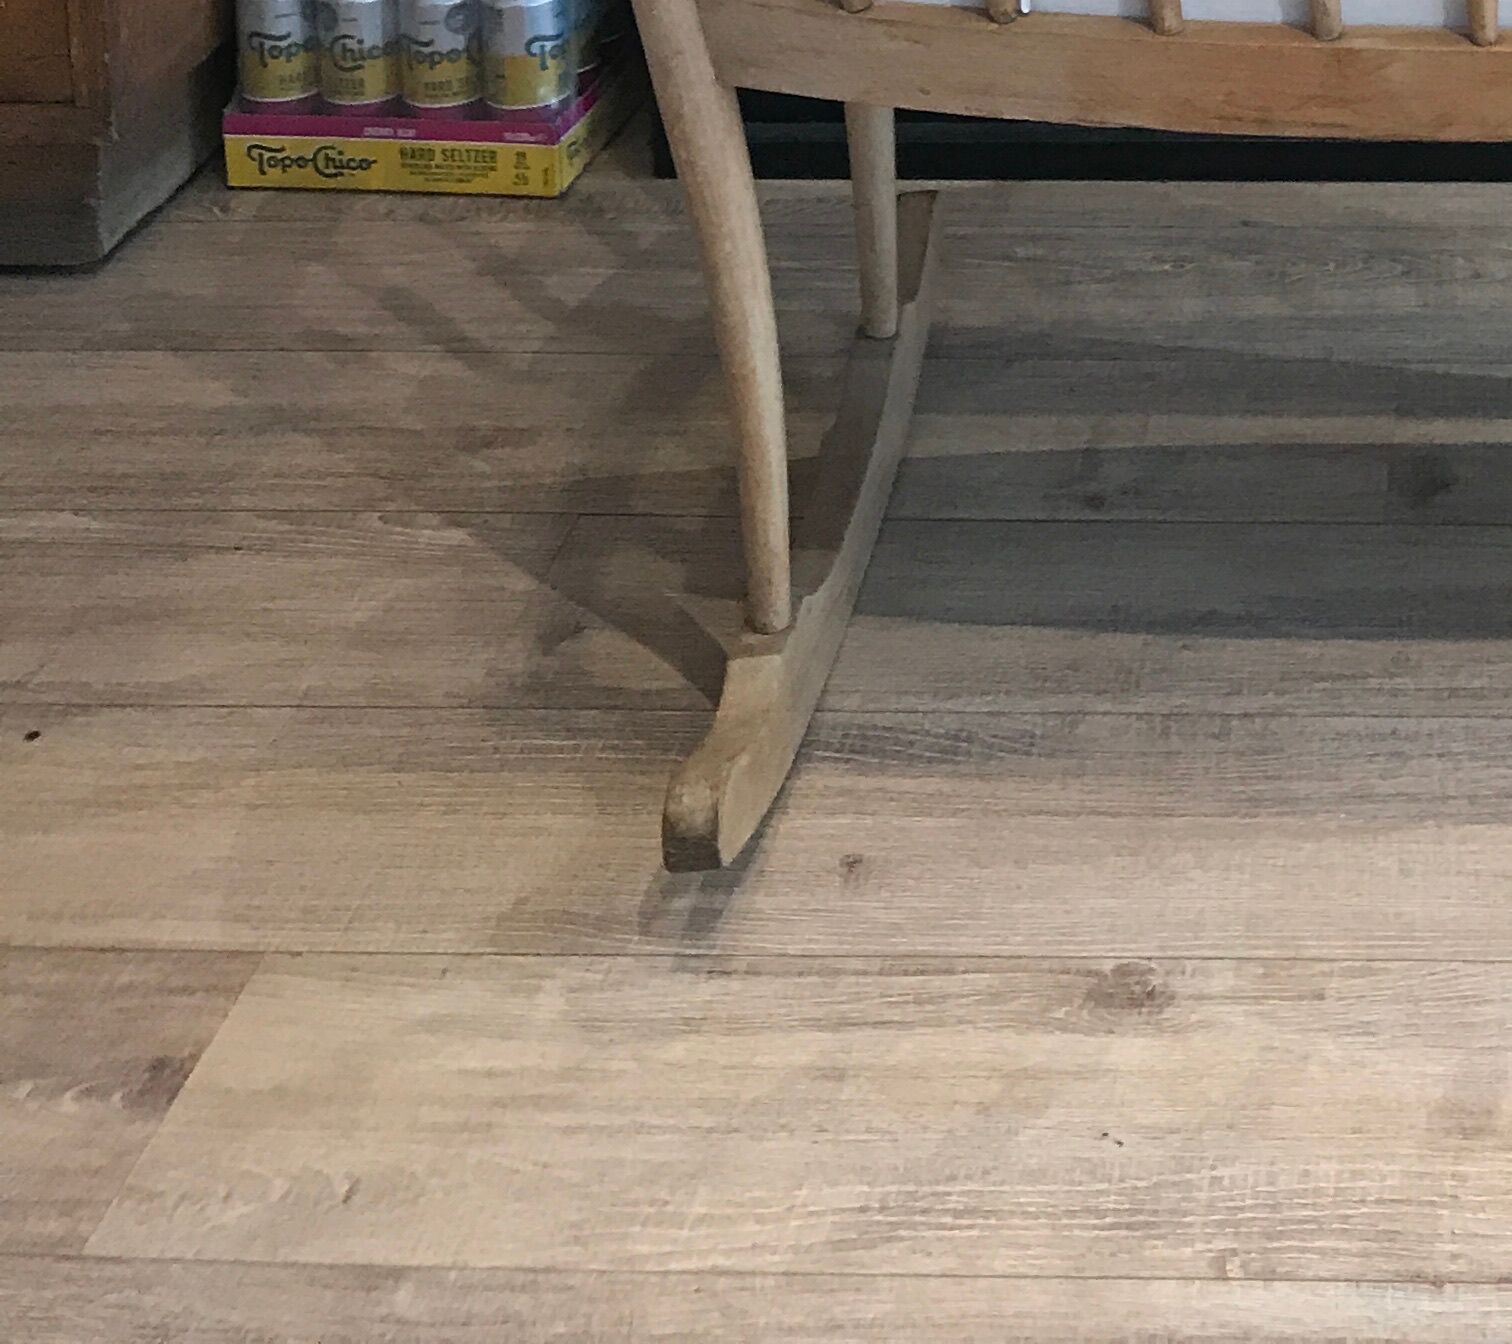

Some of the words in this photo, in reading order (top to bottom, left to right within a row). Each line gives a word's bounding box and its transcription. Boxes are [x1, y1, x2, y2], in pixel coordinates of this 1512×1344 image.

[246, 142, 314, 176] Topo
[313, 144, 378, 179] Chico
[400, 147, 436, 162] HARD
[441, 147, 498, 164] SELTZER
